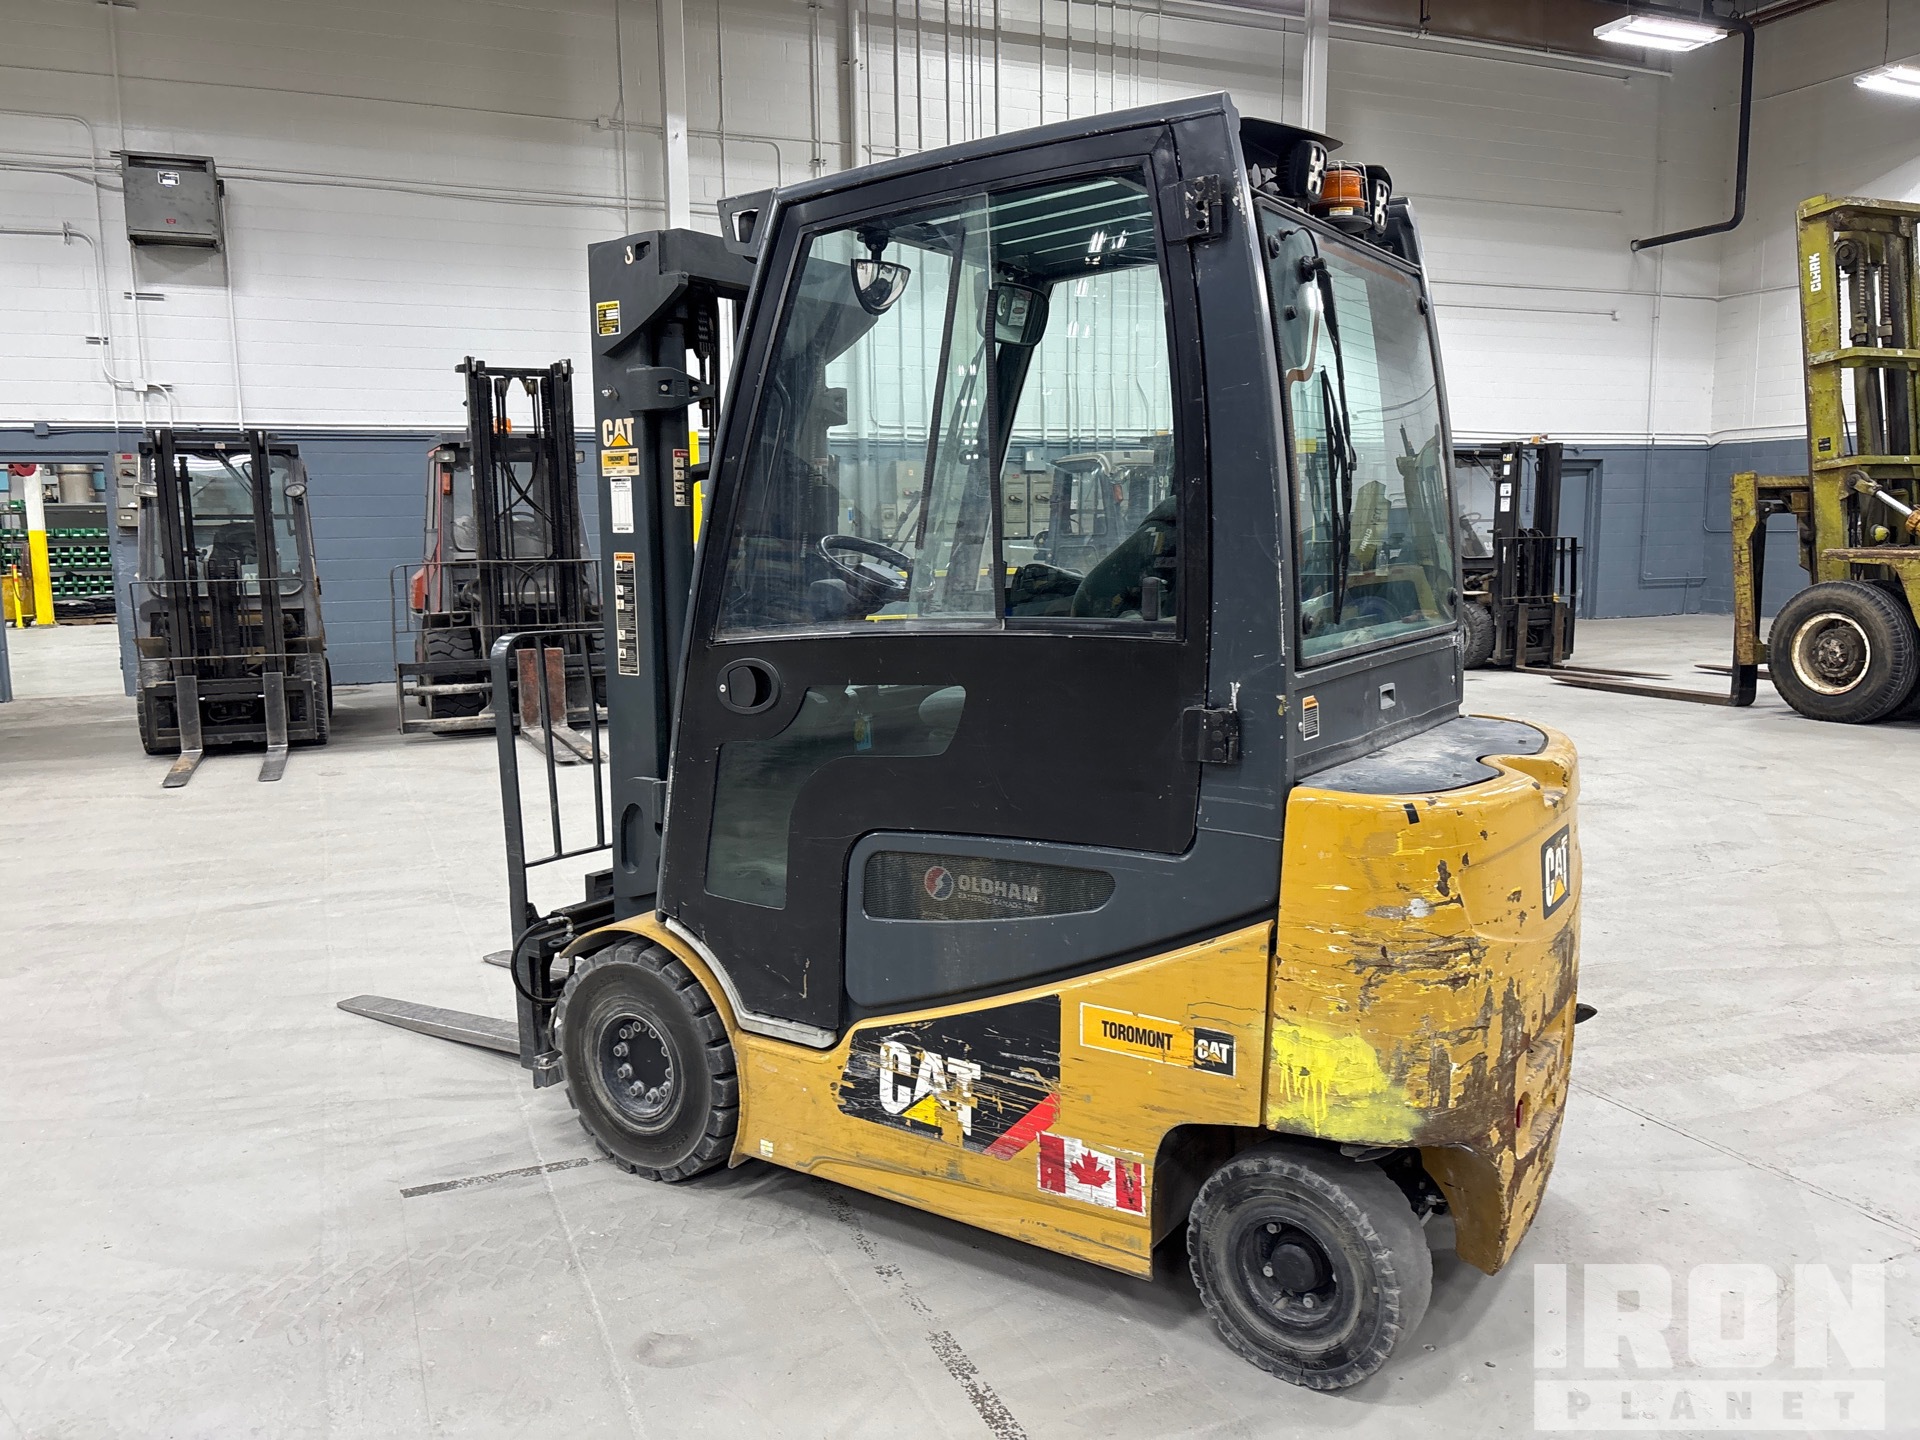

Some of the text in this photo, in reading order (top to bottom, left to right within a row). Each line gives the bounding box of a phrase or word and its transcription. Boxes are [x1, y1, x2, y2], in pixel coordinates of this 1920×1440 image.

[1809, 253, 1821, 292] CLARK
[602, 418, 634, 447] CAT
[1545, 835, 1567, 907] CAT
[957, 874, 1039, 903] OLDHAM
[1101, 1020, 1174, 1051] TOROMONT
[1197, 1039, 1231, 1065] CAT
[879, 1041, 981, 1136] CAT
